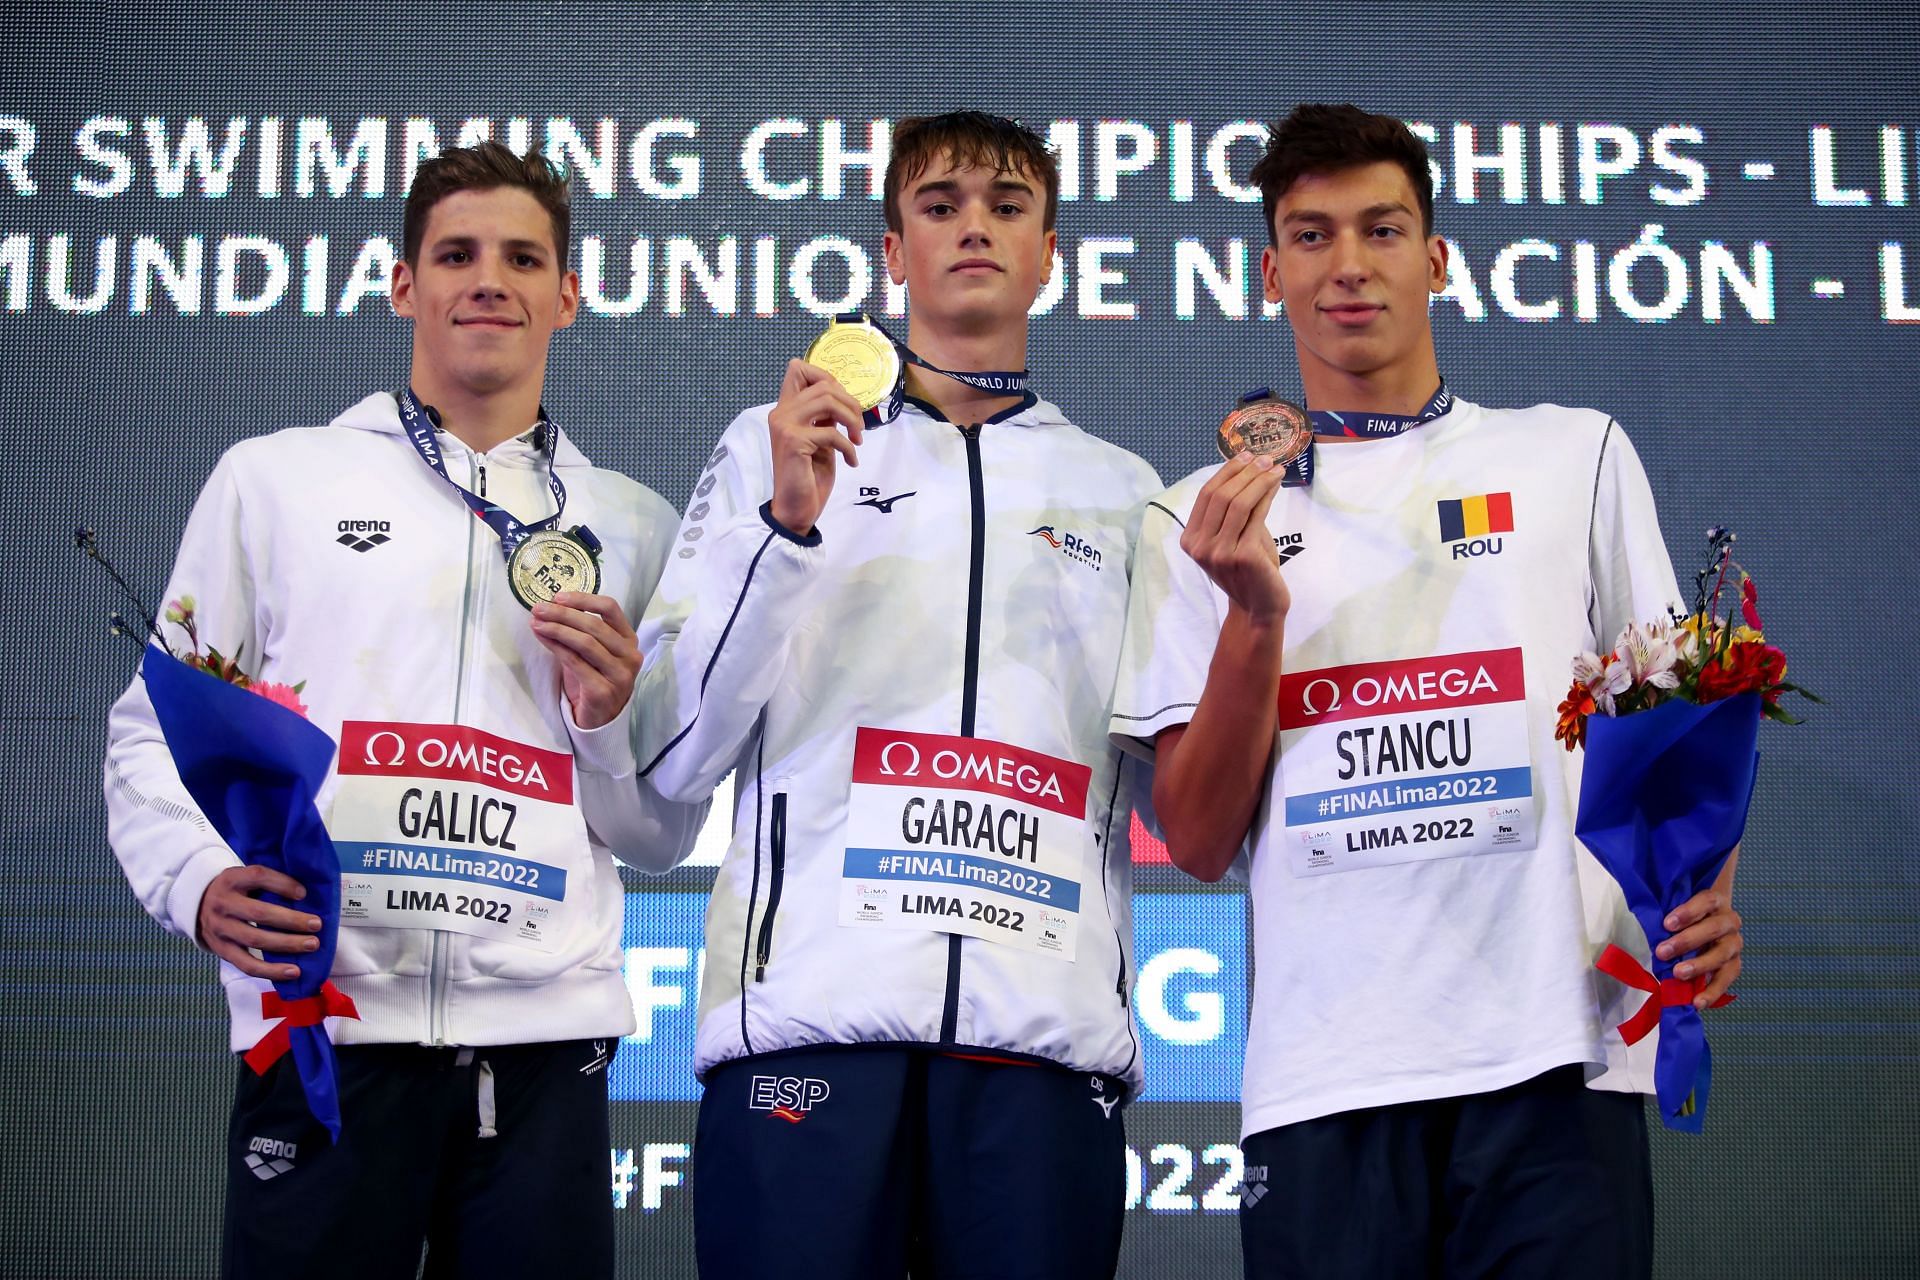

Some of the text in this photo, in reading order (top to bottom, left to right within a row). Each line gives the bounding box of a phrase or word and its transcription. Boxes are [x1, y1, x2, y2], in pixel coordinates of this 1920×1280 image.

[740, 117, 1710, 205] CHPIOHIPS
[1809, 124, 1920, 206] LI
[579, 235, 906, 319] UNIO
[1173, 223, 1776, 324] NACIÓN
[961, 375, 1003, 389] WORLD
[1367, 419, 1397, 433] FINA
[414, 429, 439, 466] LIMA
[859, 486, 881, 497] DS
[337, 519, 391, 533] arena
[1272, 532, 1303, 547] ena
[1064, 532, 1102, 564] Rfen
[1452, 537, 1503, 561] ROU
[1352, 665, 1499, 707] OMEGA
[417, 739, 549, 791] OMEGA
[1336, 717, 1473, 781] STANCU
[932, 750, 1065, 804] OMEGA
[1318, 776, 1499, 816] #FINALima2022
[398, 787, 518, 852] GALICZ
[902, 796, 1040, 864] GARACH
[1345, 826, 1409, 853] LIMA
[1412, 817, 1475, 844] 2022
[362, 849, 540, 889] #FINALima2022
[878, 855, 1053, 899] #FINALima2022
[386, 889, 513, 924] LIMA 2022
[901, 894, 1026, 932] LIMA 2022
[750, 1075, 830, 1111] ESP
[249, 1136, 297, 1160] arena
